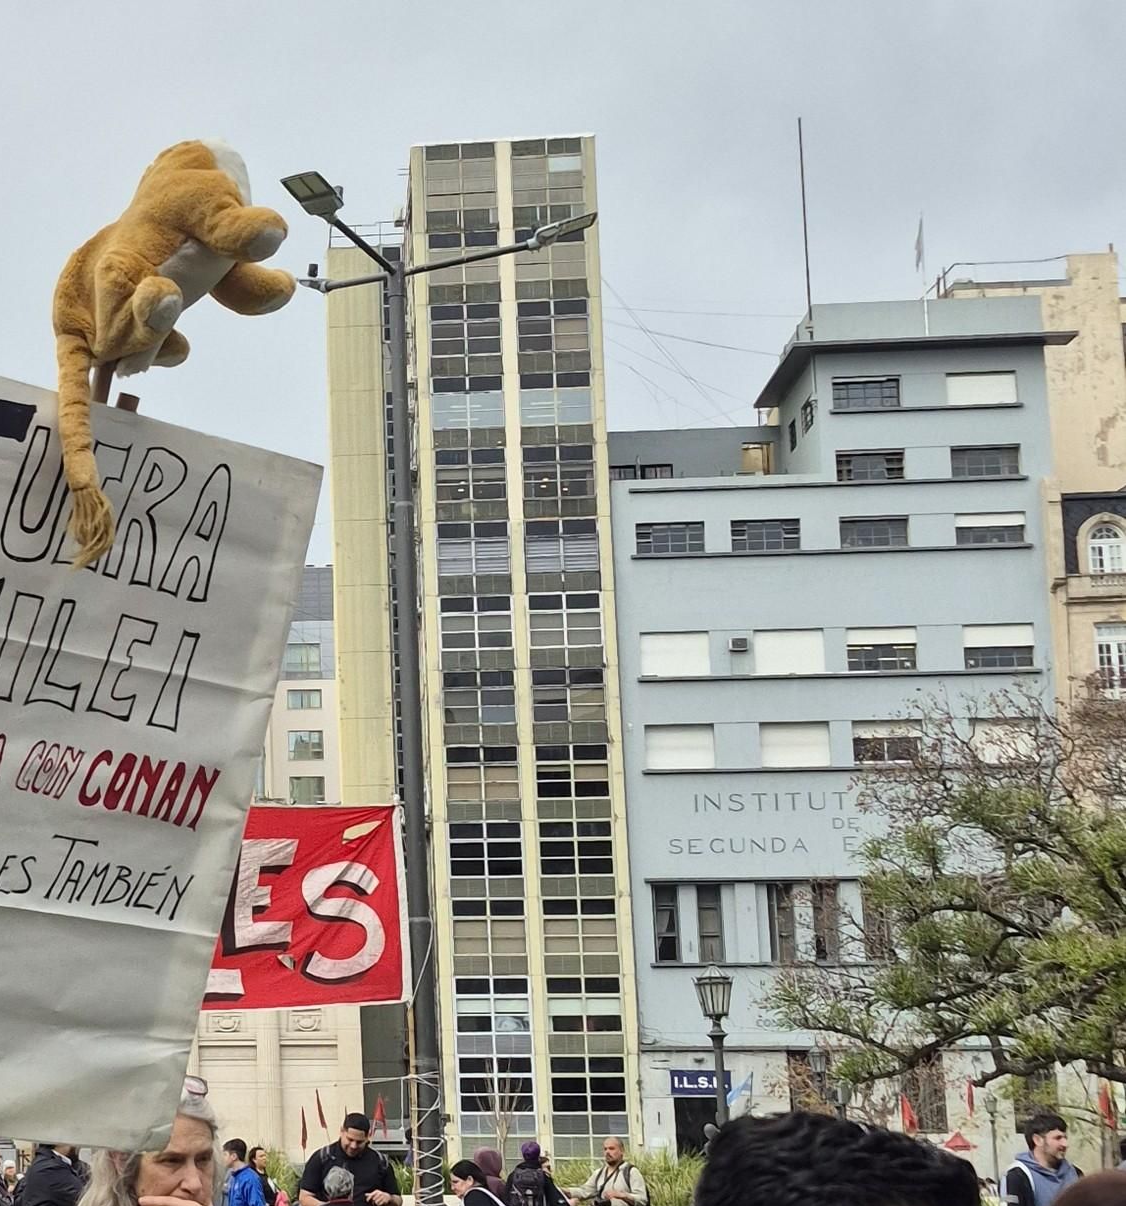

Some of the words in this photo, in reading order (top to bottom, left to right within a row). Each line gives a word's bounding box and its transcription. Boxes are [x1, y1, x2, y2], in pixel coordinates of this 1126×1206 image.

[15, 740, 85, 800] CON
[78, 750, 221, 832] CONAN
[694, 791, 854, 813] INSTITUT
[831, 816, 859, 831] DE
[668, 837, 810, 856] SEGUNDA
[44, 834, 195, 921] TAMBIÉN
